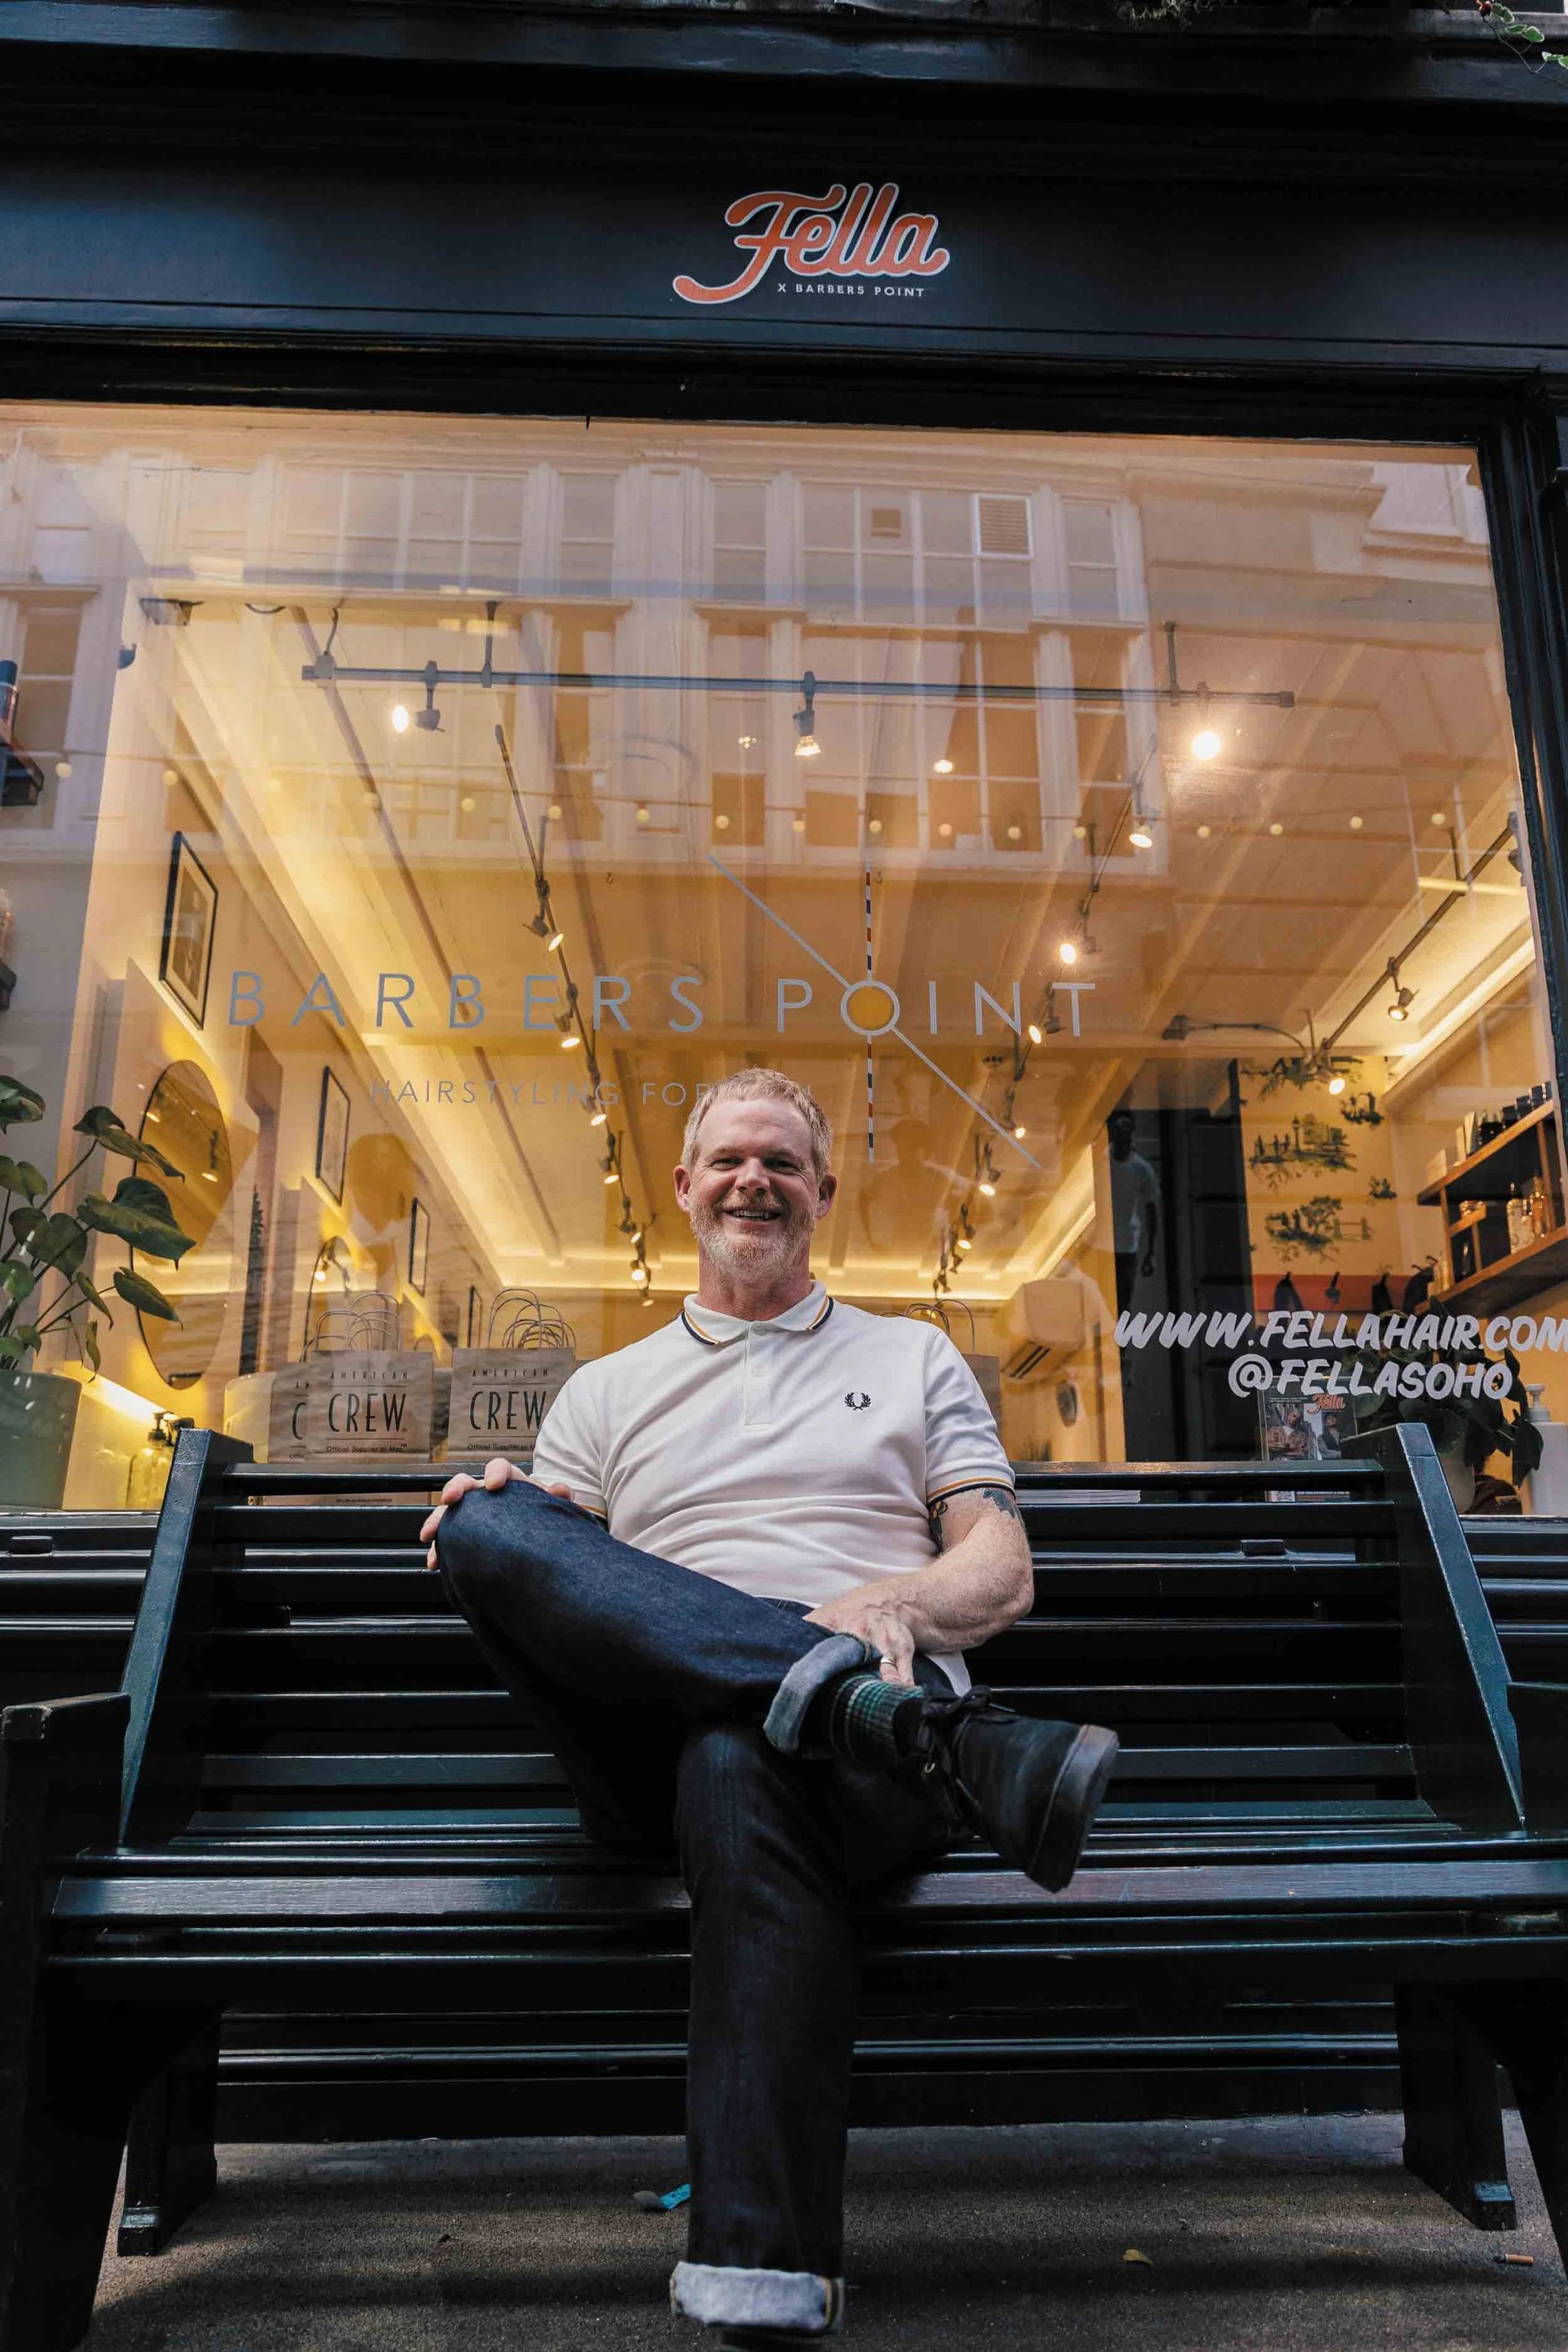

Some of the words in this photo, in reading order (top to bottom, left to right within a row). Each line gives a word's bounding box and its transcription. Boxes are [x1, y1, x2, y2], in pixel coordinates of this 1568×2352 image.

[672, 183, 950, 304] Fella
[777, 283, 787, 293] X
[795, 284, 865, 295] BARBERS
[874, 286, 925, 297] POINT
[228, 971, 704, 1033] BARBERS
[777, 978, 1096, 1037] POINT
[371, 1079, 619, 1106] HAIRSTYLING
[1113, 1310, 1568, 1352] WWW.FELLAHAIR.COM
[330, 1370, 409, 1380] AMERICAN
[472, 1368, 548, 1378] AMERICAN
[1228, 1353, 1513, 1400] @FELLASOHO
[328, 1393, 406, 1432] CREW
[470, 1390, 546, 1430] CREW
[1307, 1393, 1345, 1414] Fella
